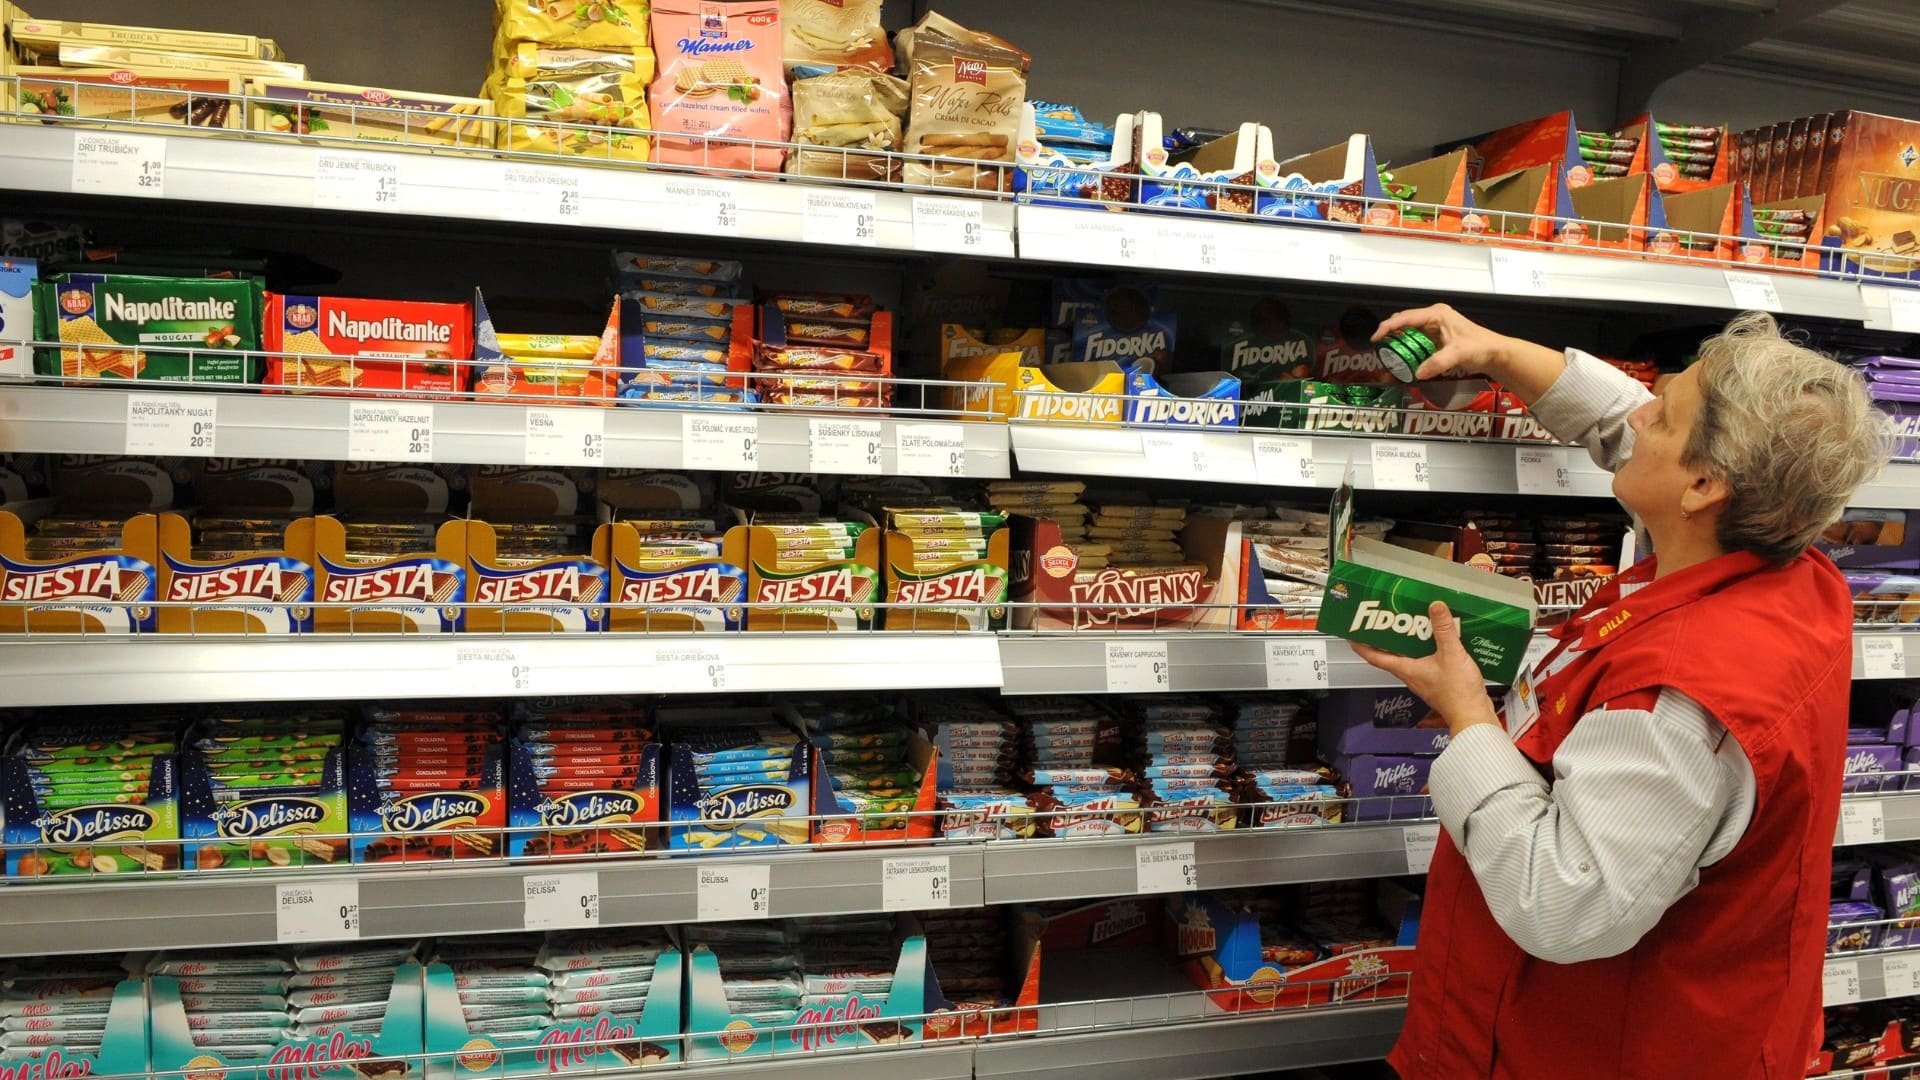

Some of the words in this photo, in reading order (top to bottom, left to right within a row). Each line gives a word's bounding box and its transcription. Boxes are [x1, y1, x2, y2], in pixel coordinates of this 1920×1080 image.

[677, 39, 755, 55] Manner
[79, 143, 97, 153] DRU
[104, 292, 236, 325] Napolitanke
[154, 333, 194, 342] NOUGAT
[327, 309, 452, 344] Napolitanke
[1083, 331, 1166, 363] FIDORKA
[1231, 340, 1310, 372] FIDORKA
[132, 407, 185, 417] NAPOLITANKY
[187, 408, 214, 417] NUGAT
[1023, 384, 1121, 421] FIDORKA
[1134, 388, 1237, 426] FIDORKA
[1303, 397, 1401, 434] FIDORKA
[353, 414, 396, 424] NAPOLITANKY
[529, 418, 554, 428] VESNA
[818, 428, 851, 440] SUŠIENKY
[1402, 402, 1491, 437] FIDORKA
[5, 560, 121, 601] SIESTA
[171, 561, 282, 601] SIESTA
[326, 563, 434, 602] SIESTA
[477, 566, 580, 603] SIESTA
[620, 567, 721, 603] SIESTA
[760, 568, 854, 604] SIESTA
[894, 568, 986, 604] SIESTA
[1070, 566, 1202, 630] KÁVENKY
[1349, 600, 1462, 642] FIDOR
[1599, 609, 1632, 638] BILLA
[1374, 695, 1415, 720] Milka
[1374, 762, 1418, 790] Milka
[378, 805, 403, 817] Orion
[394, 799, 478, 833] Delissa
[536, 803, 562, 814] Orion
[556, 799, 634, 830] Delissa
[696, 798, 719, 810] Orion
[711, 790, 787, 820] Delissa
[1052, 797, 1119, 824] SIESTA
[36, 816, 62, 828] Orion
[54, 811, 147, 843] Delissa
[212, 810, 238, 822] Orion
[230, 805, 318, 838] Delissa
[526, 886, 557, 896] DELISSA
[701, 876, 729, 885] DELISSA
[281, 896, 314, 906] DELISSA
[269, 1031, 373, 1080] Mila
[535, 1017, 634, 1073] Mila
